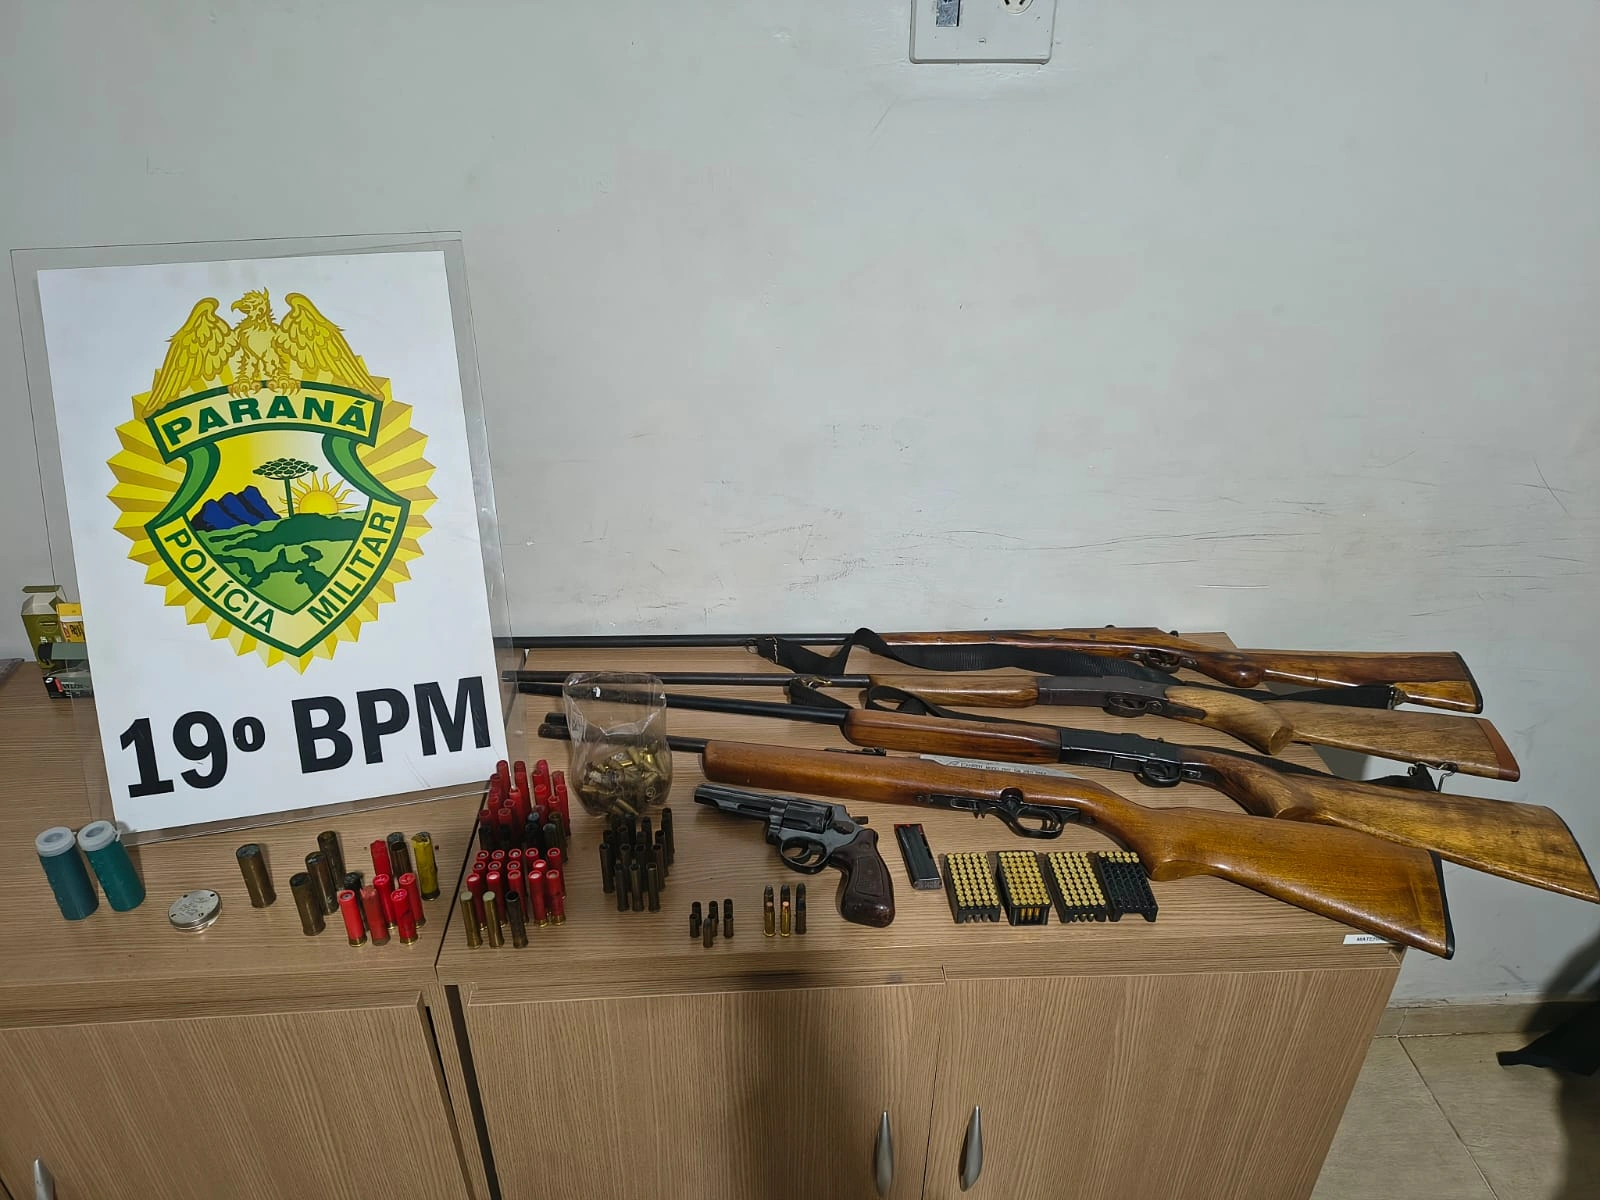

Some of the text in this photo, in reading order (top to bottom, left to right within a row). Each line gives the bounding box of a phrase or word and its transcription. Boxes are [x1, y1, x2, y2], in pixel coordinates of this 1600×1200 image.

[161, 395, 367, 446] PARANÁ
[164, 511, 396, 634] POLÍCIA MILITAR
[290, 675, 492, 774] BPM
